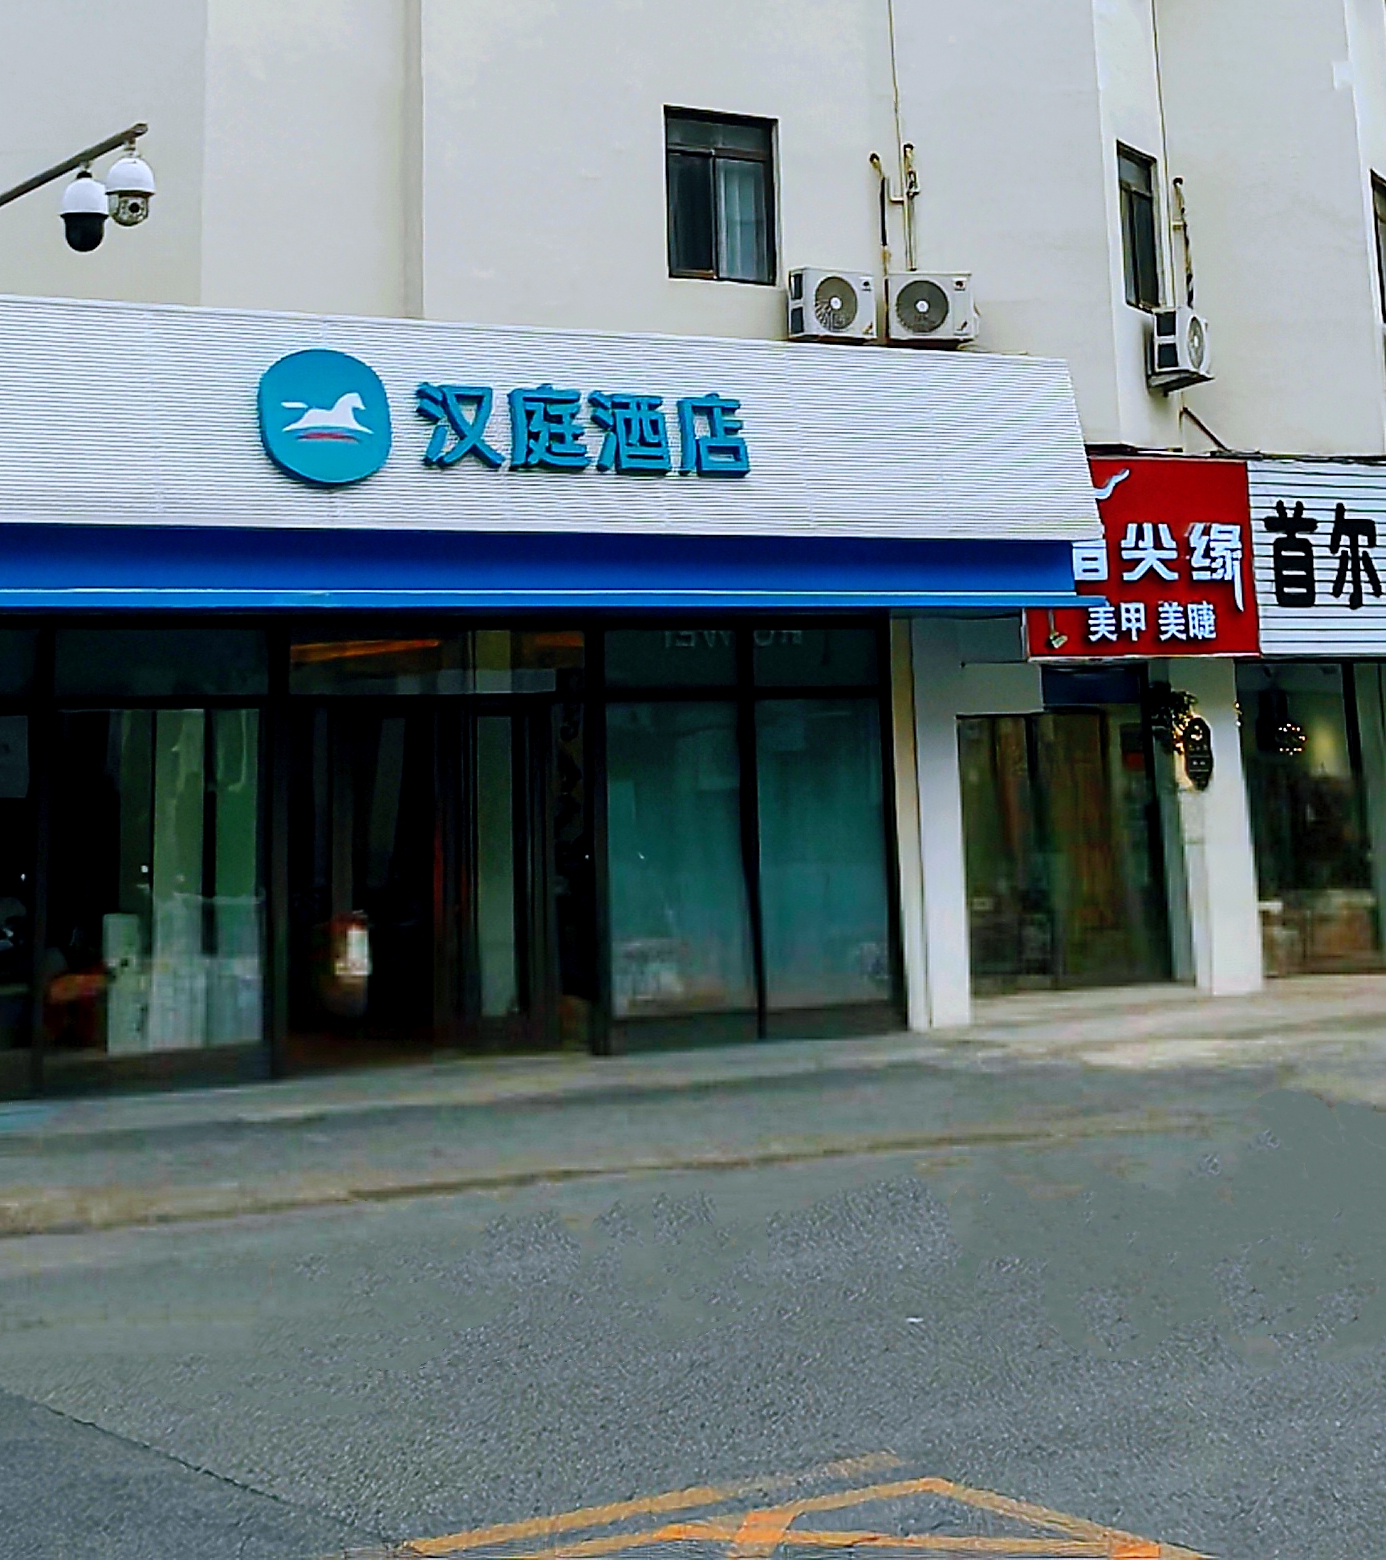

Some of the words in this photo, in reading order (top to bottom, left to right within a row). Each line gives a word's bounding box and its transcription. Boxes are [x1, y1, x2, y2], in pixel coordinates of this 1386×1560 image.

[416, 382, 749, 478] 汉庭酒店
[1088, 602, 1146, 641] 美甲
[1158, 601, 1216, 641] 美睫
